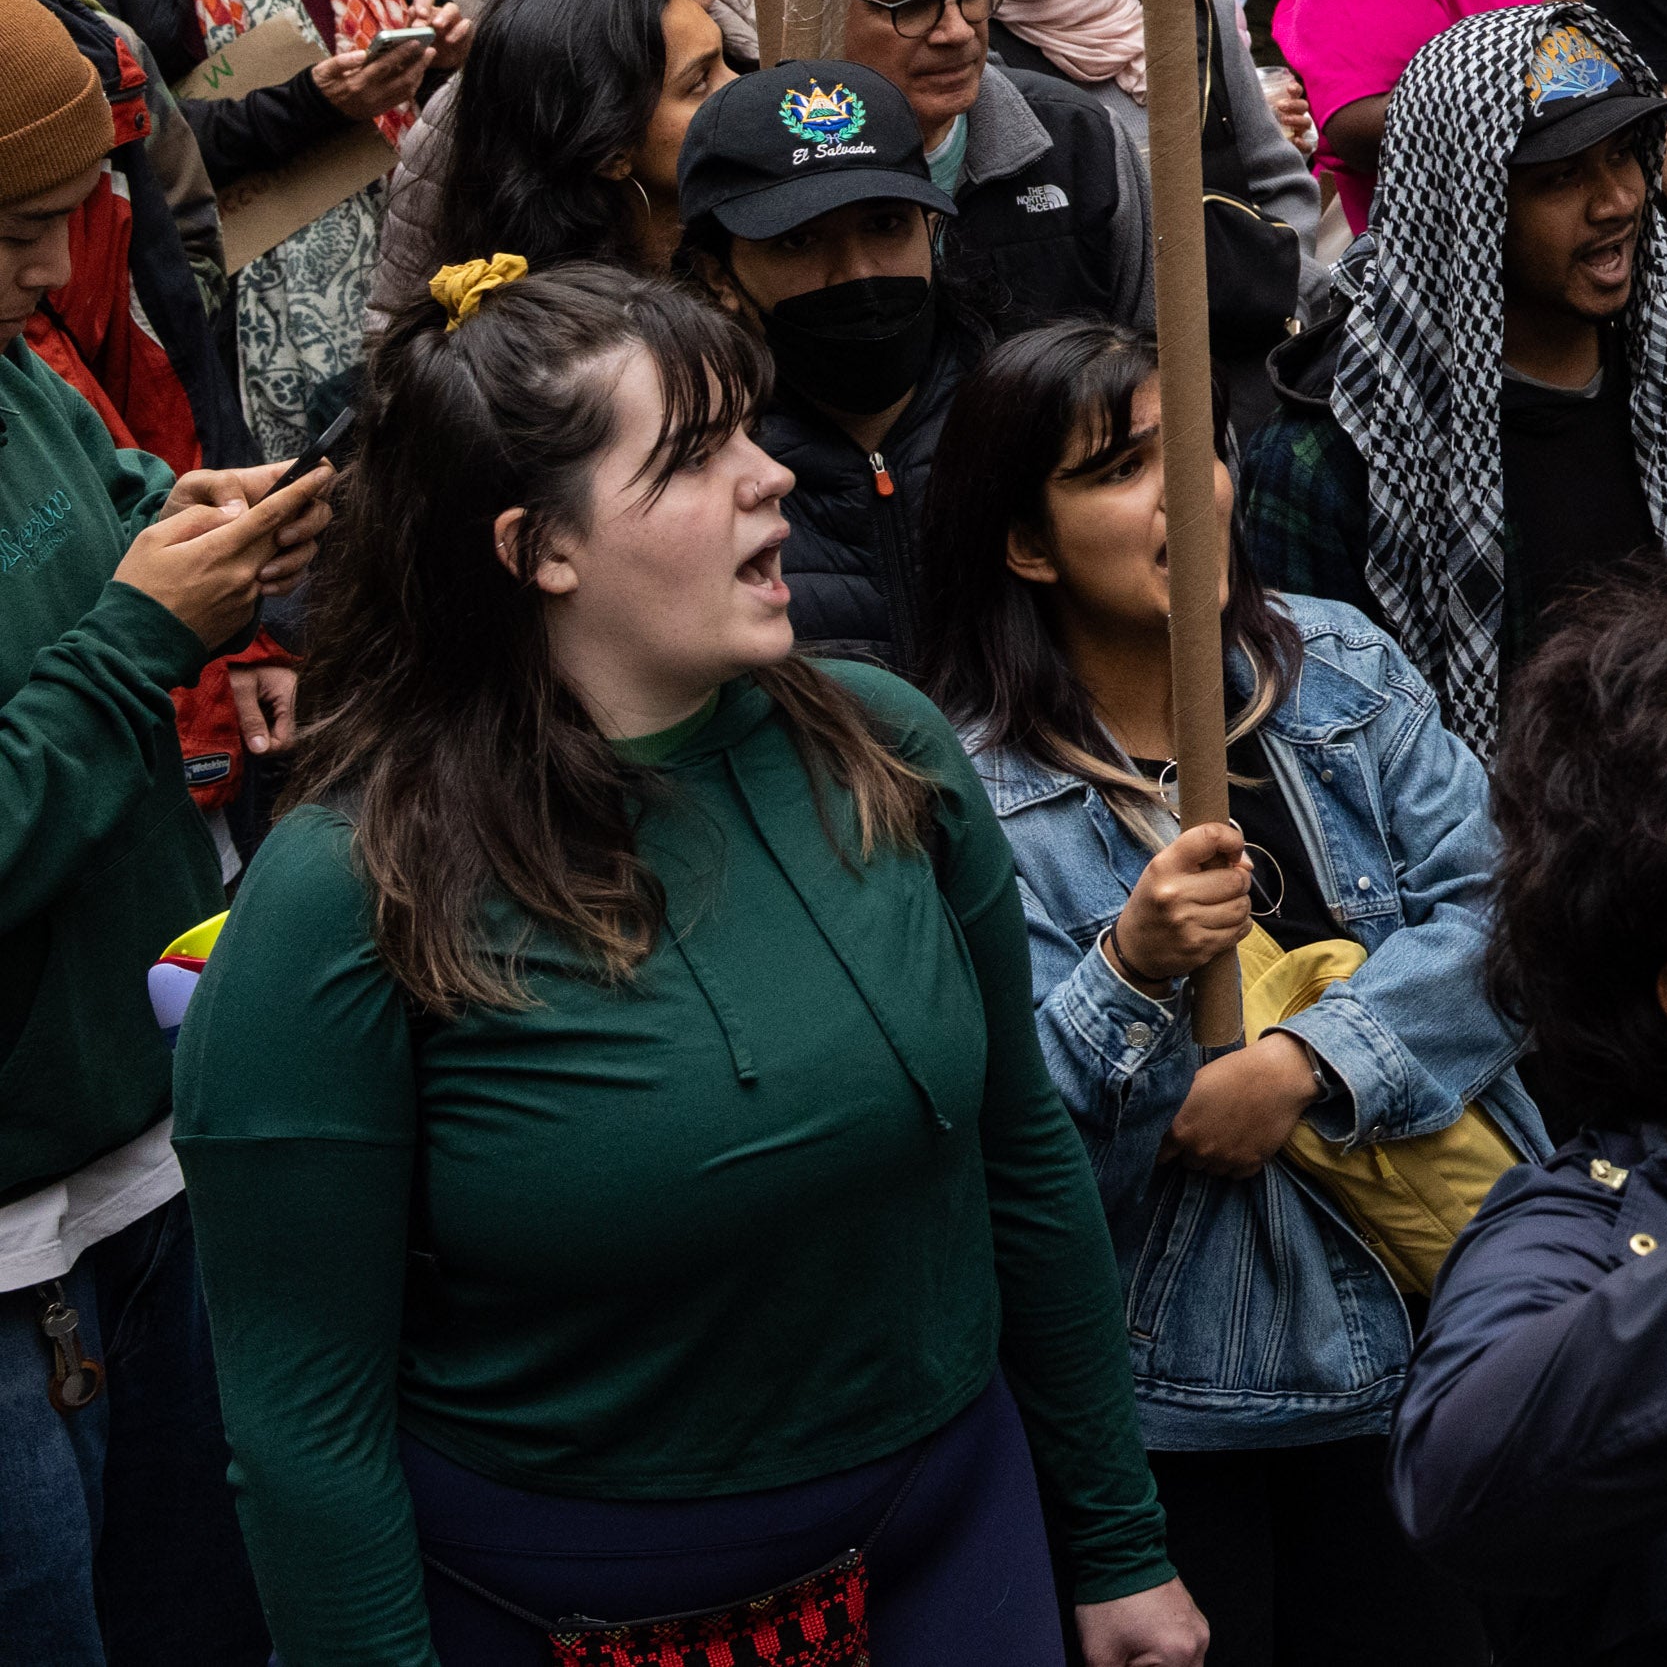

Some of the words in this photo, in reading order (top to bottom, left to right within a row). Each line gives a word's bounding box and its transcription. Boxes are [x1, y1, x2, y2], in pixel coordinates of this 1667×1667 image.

[792, 144, 810, 166] El
[814, 141, 877, 160] Salvador
[1027, 186, 1045, 195] THE
[1016, 194, 1047, 205] NORTH
[1027, 203, 1050, 213] FACE
